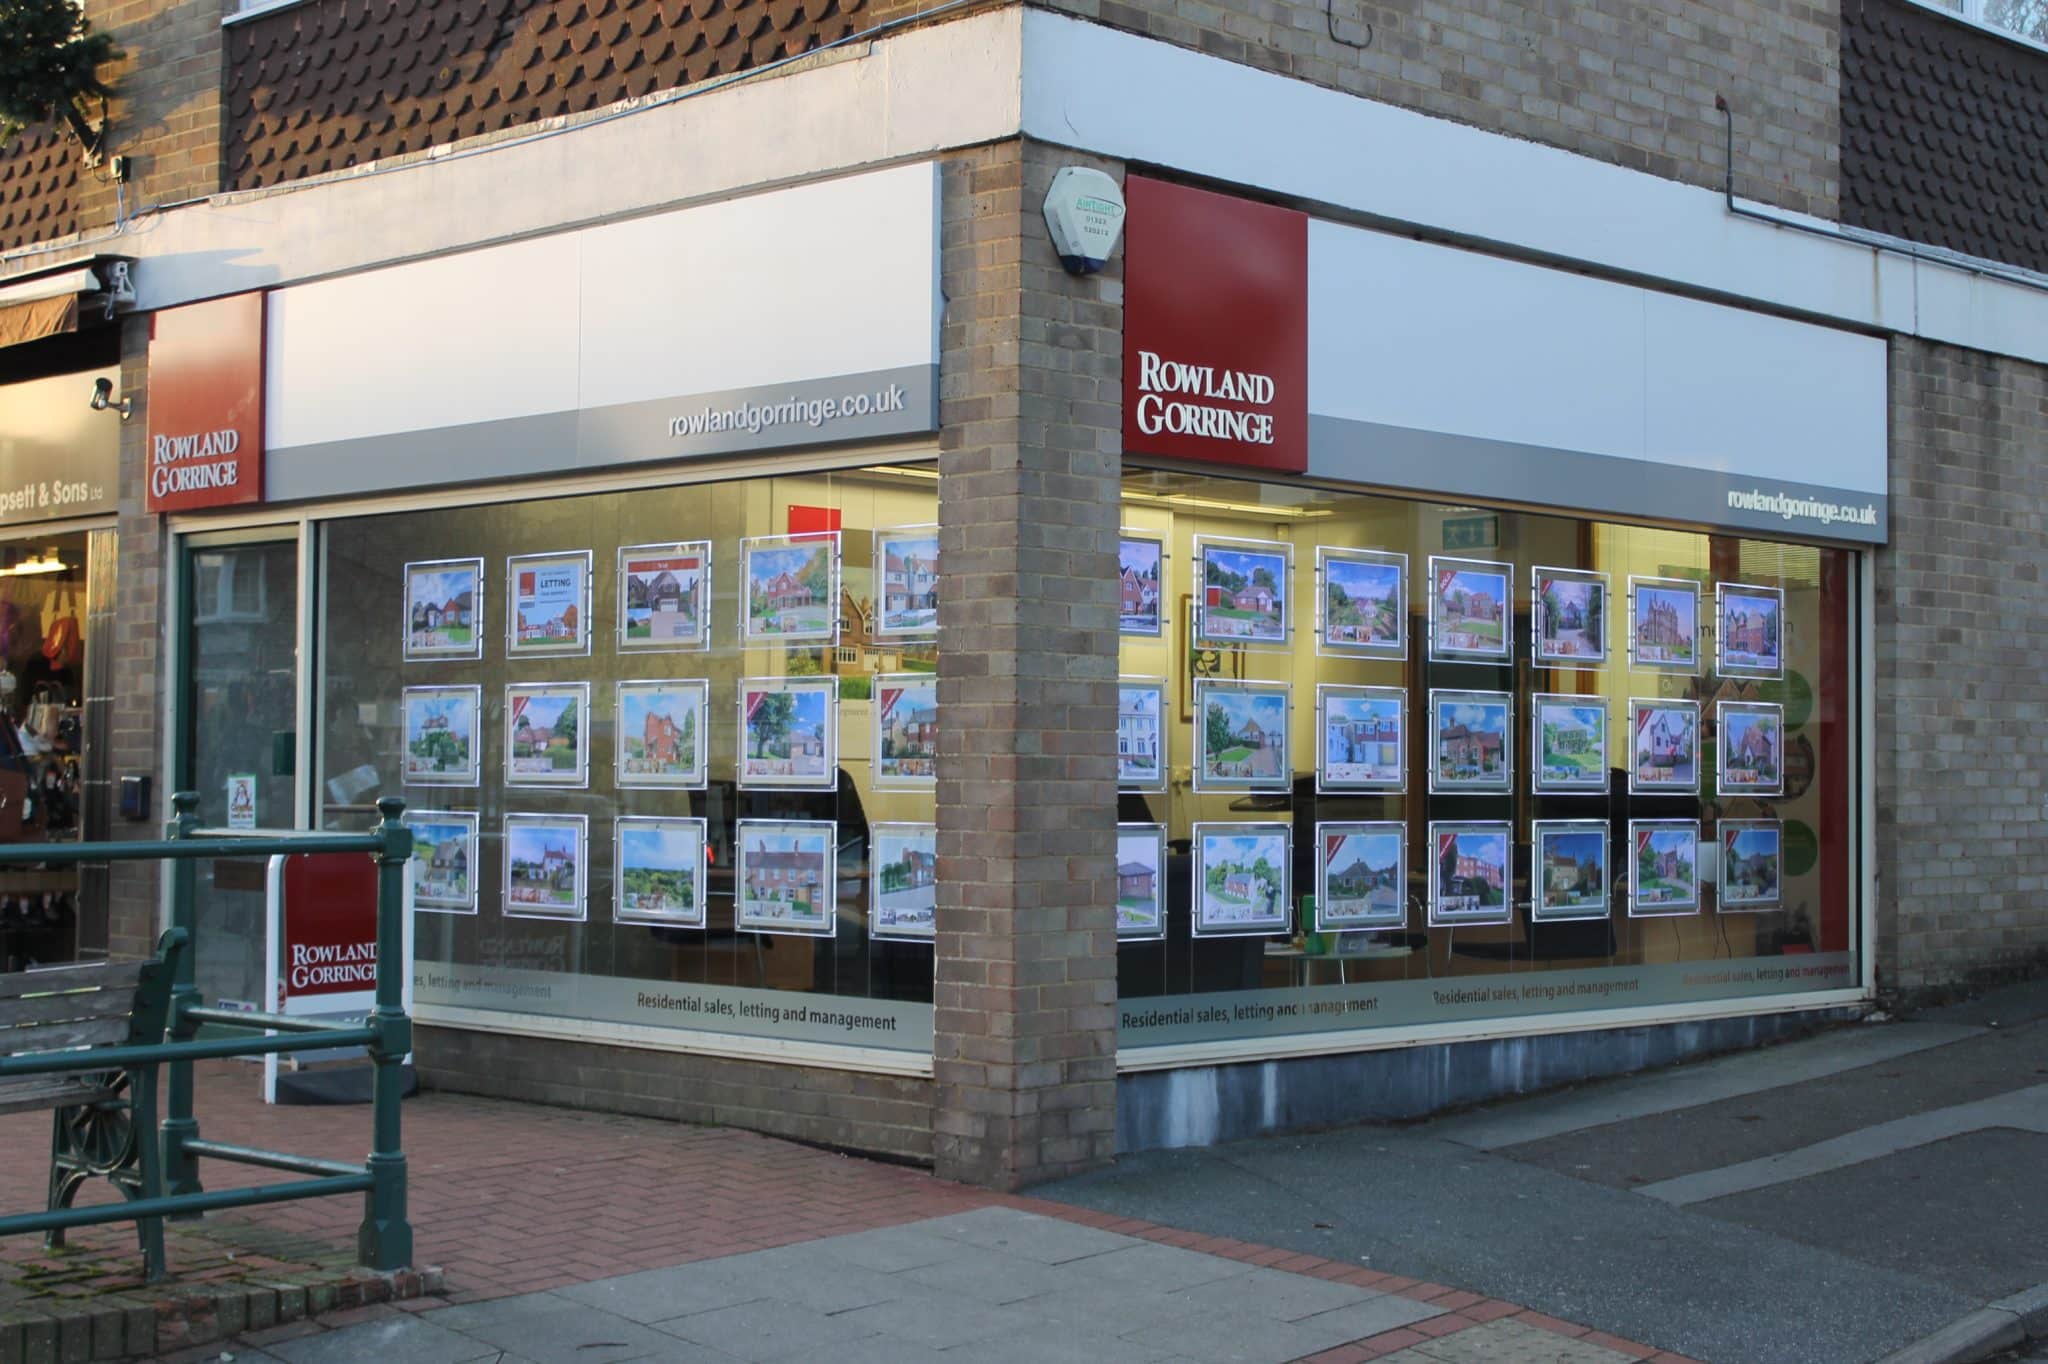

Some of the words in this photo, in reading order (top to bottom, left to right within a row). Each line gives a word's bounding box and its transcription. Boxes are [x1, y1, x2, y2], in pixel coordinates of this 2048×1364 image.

[1138, 351, 1275, 405] ROWLAND
[668, 384, 905, 437] rowlandgorringe.co.uk
[1137, 394, 1274, 445] GORRINGE
[154, 429, 240, 466] ROWLAND
[38, 482, 49, 507] &
[53, 480, 88, 505] Sons
[152, 460, 239, 498] GORRINGE
[1727, 489, 1877, 526] rowlandgorringe.co.uk
[540, 578, 571, 589] LETTING
[428, 973, 461, 993] letting
[1433, 987, 1490, 1006] Residential
[1492, 985, 1520, 1003] sales,
[1522, 983, 1554, 1000] letting
[1556, 980, 1576, 996] and
[1577, 978, 1639, 996] management
[1756, 967, 1784, 982] letting
[1785, 965, 1801, 979] and
[637, 991, 701, 1014] Residential
[704, 998, 736, 1019] sales,
[739, 1001, 780, 1024] letting
[783, 1006, 807, 1022] and
[809, 1012, 897, 1032] management
[1122, 1007, 1194, 1029] Residential
[1197, 1006, 1231, 1025] sales,
[1233, 1002, 1274, 1022] letting
